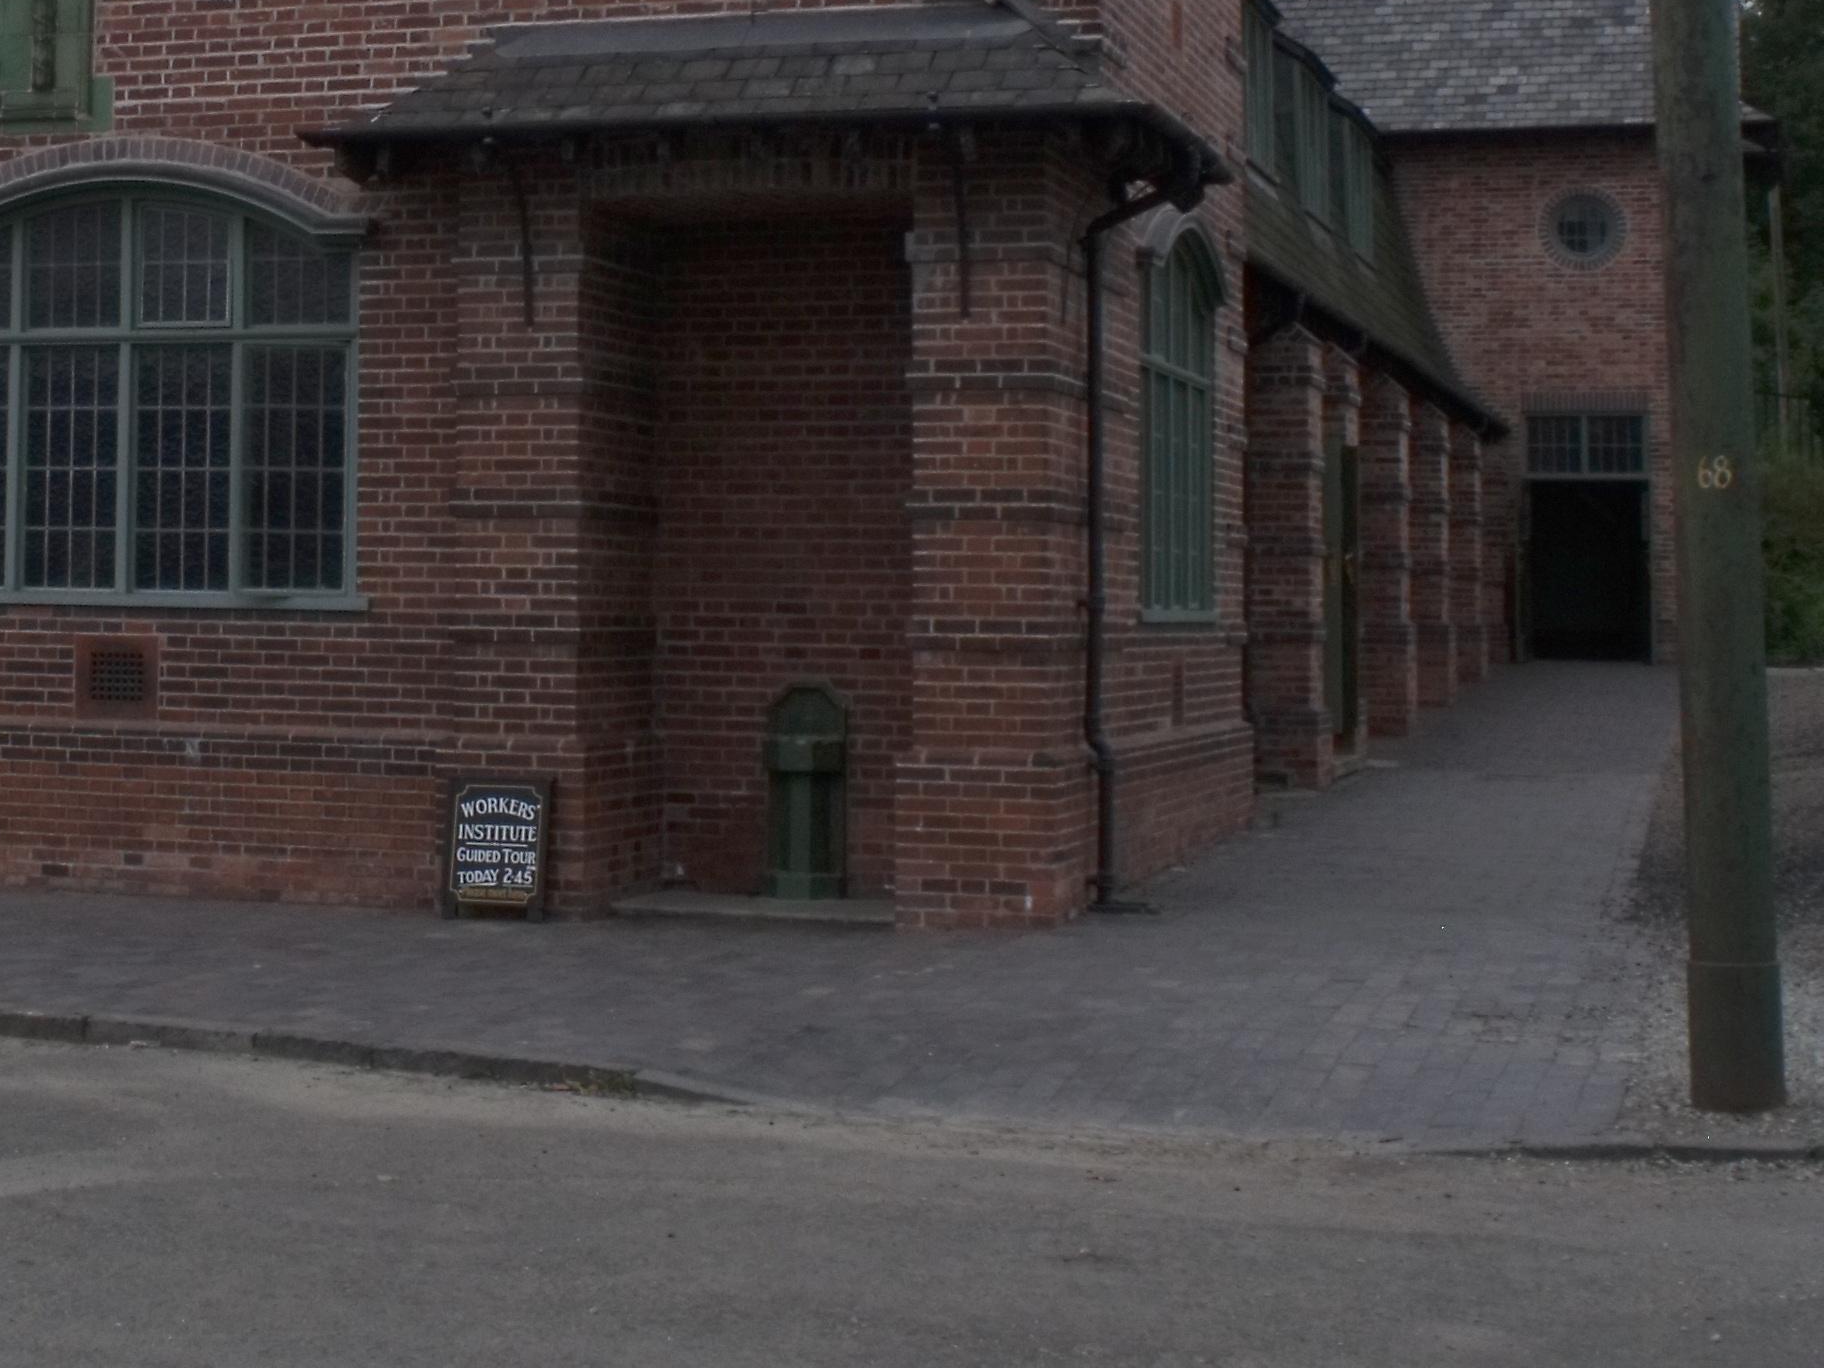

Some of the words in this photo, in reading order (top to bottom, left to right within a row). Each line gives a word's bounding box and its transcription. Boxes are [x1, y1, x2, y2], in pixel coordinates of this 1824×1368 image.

[1698, 455, 1732, 489] 68
[458, 823, 537, 842] INSTITUTE
[457, 846, 501, 863] GUIDED
[502, 848, 536, 865] TOUR
[457, 869, 499, 884] TODAY
